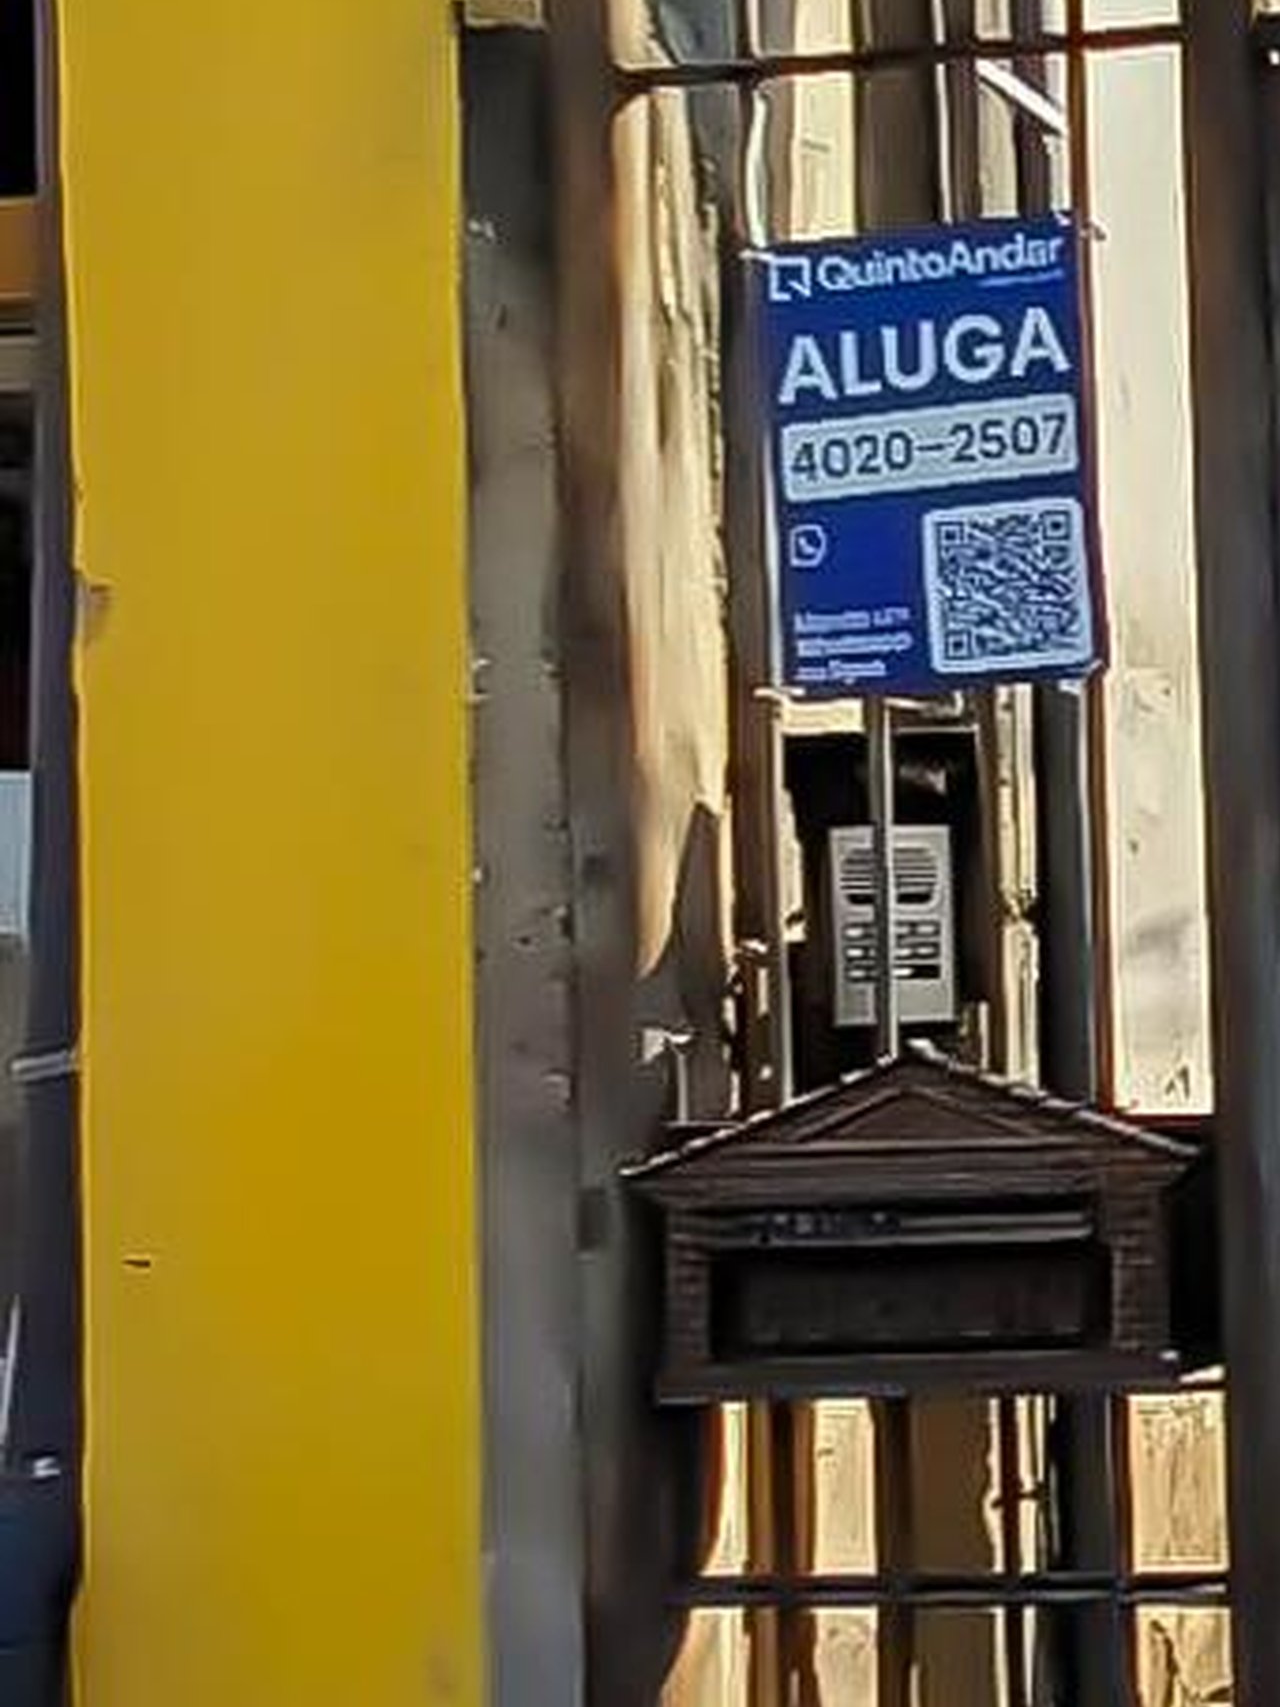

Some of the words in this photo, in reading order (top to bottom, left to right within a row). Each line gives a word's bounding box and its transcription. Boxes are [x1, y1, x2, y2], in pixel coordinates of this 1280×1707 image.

[816, 232, 1064, 291] QuintoAndar
[778, 306, 1071, 404] ALUGA
[791, 412, 1068, 482] 4020-2507
